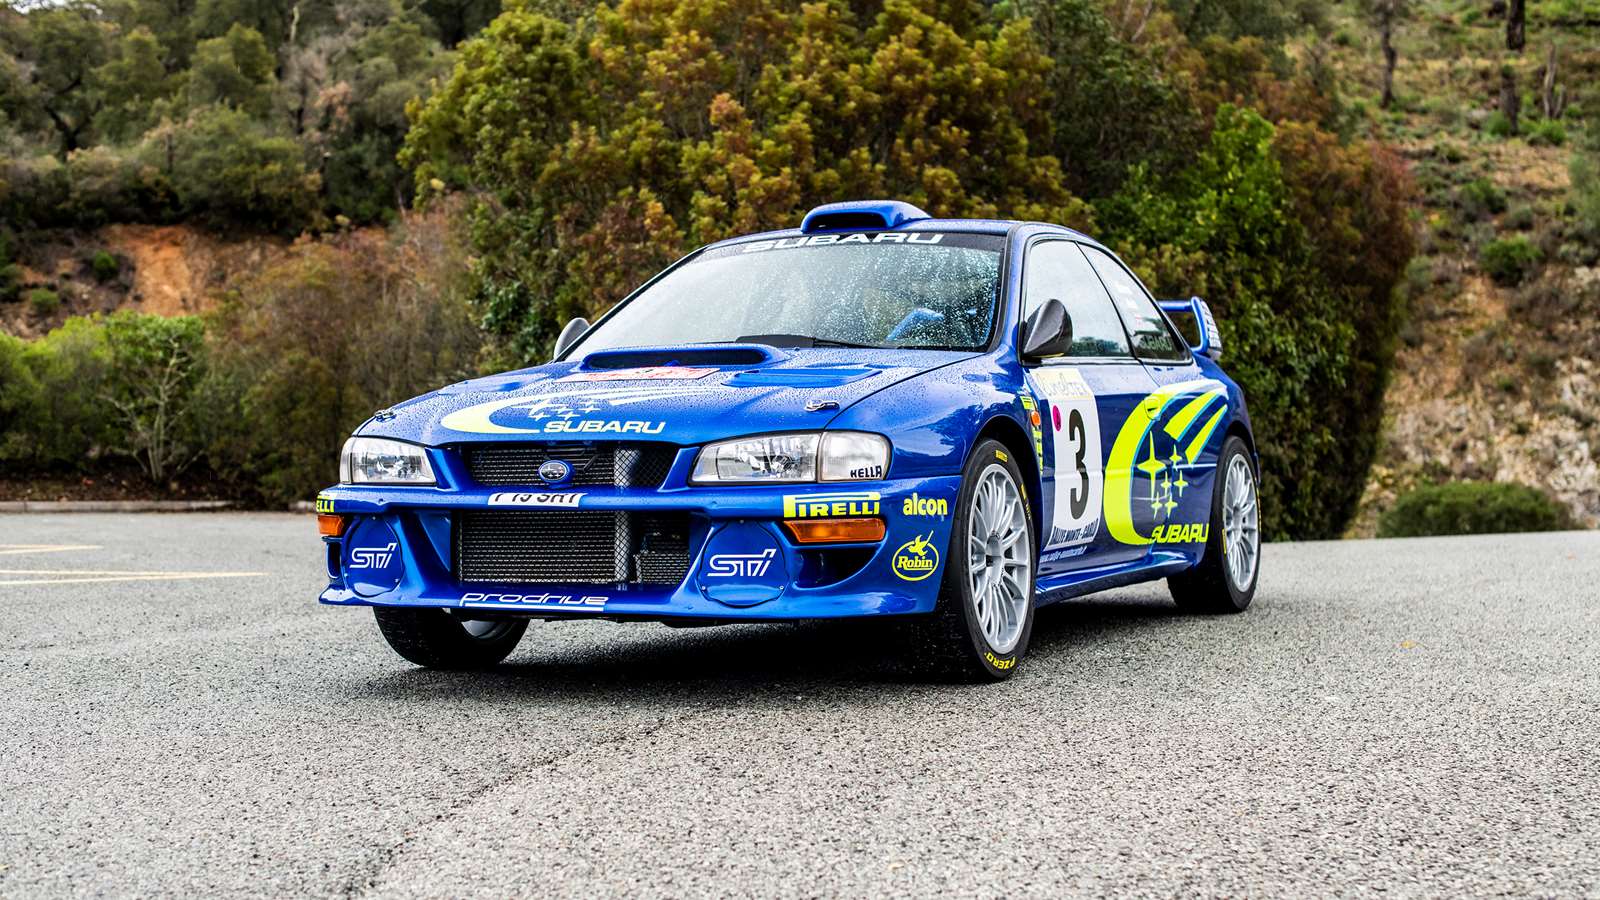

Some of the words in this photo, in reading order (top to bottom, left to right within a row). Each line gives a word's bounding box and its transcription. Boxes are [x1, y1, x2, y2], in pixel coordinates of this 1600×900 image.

[743, 232, 945, 253] SUBARU
[543, 420, 666, 434] SUBARU
[850, 465, 882, 478] HELLA
[1068, 408, 1090, 520] 3
[783, 492, 881, 518] PIRELLI
[903, 492, 948, 517] alcon
[1151, 523, 1210, 544] SUBARU
[898, 555, 934, 571] Robin
[459, 592, 609, 606] prodrive
